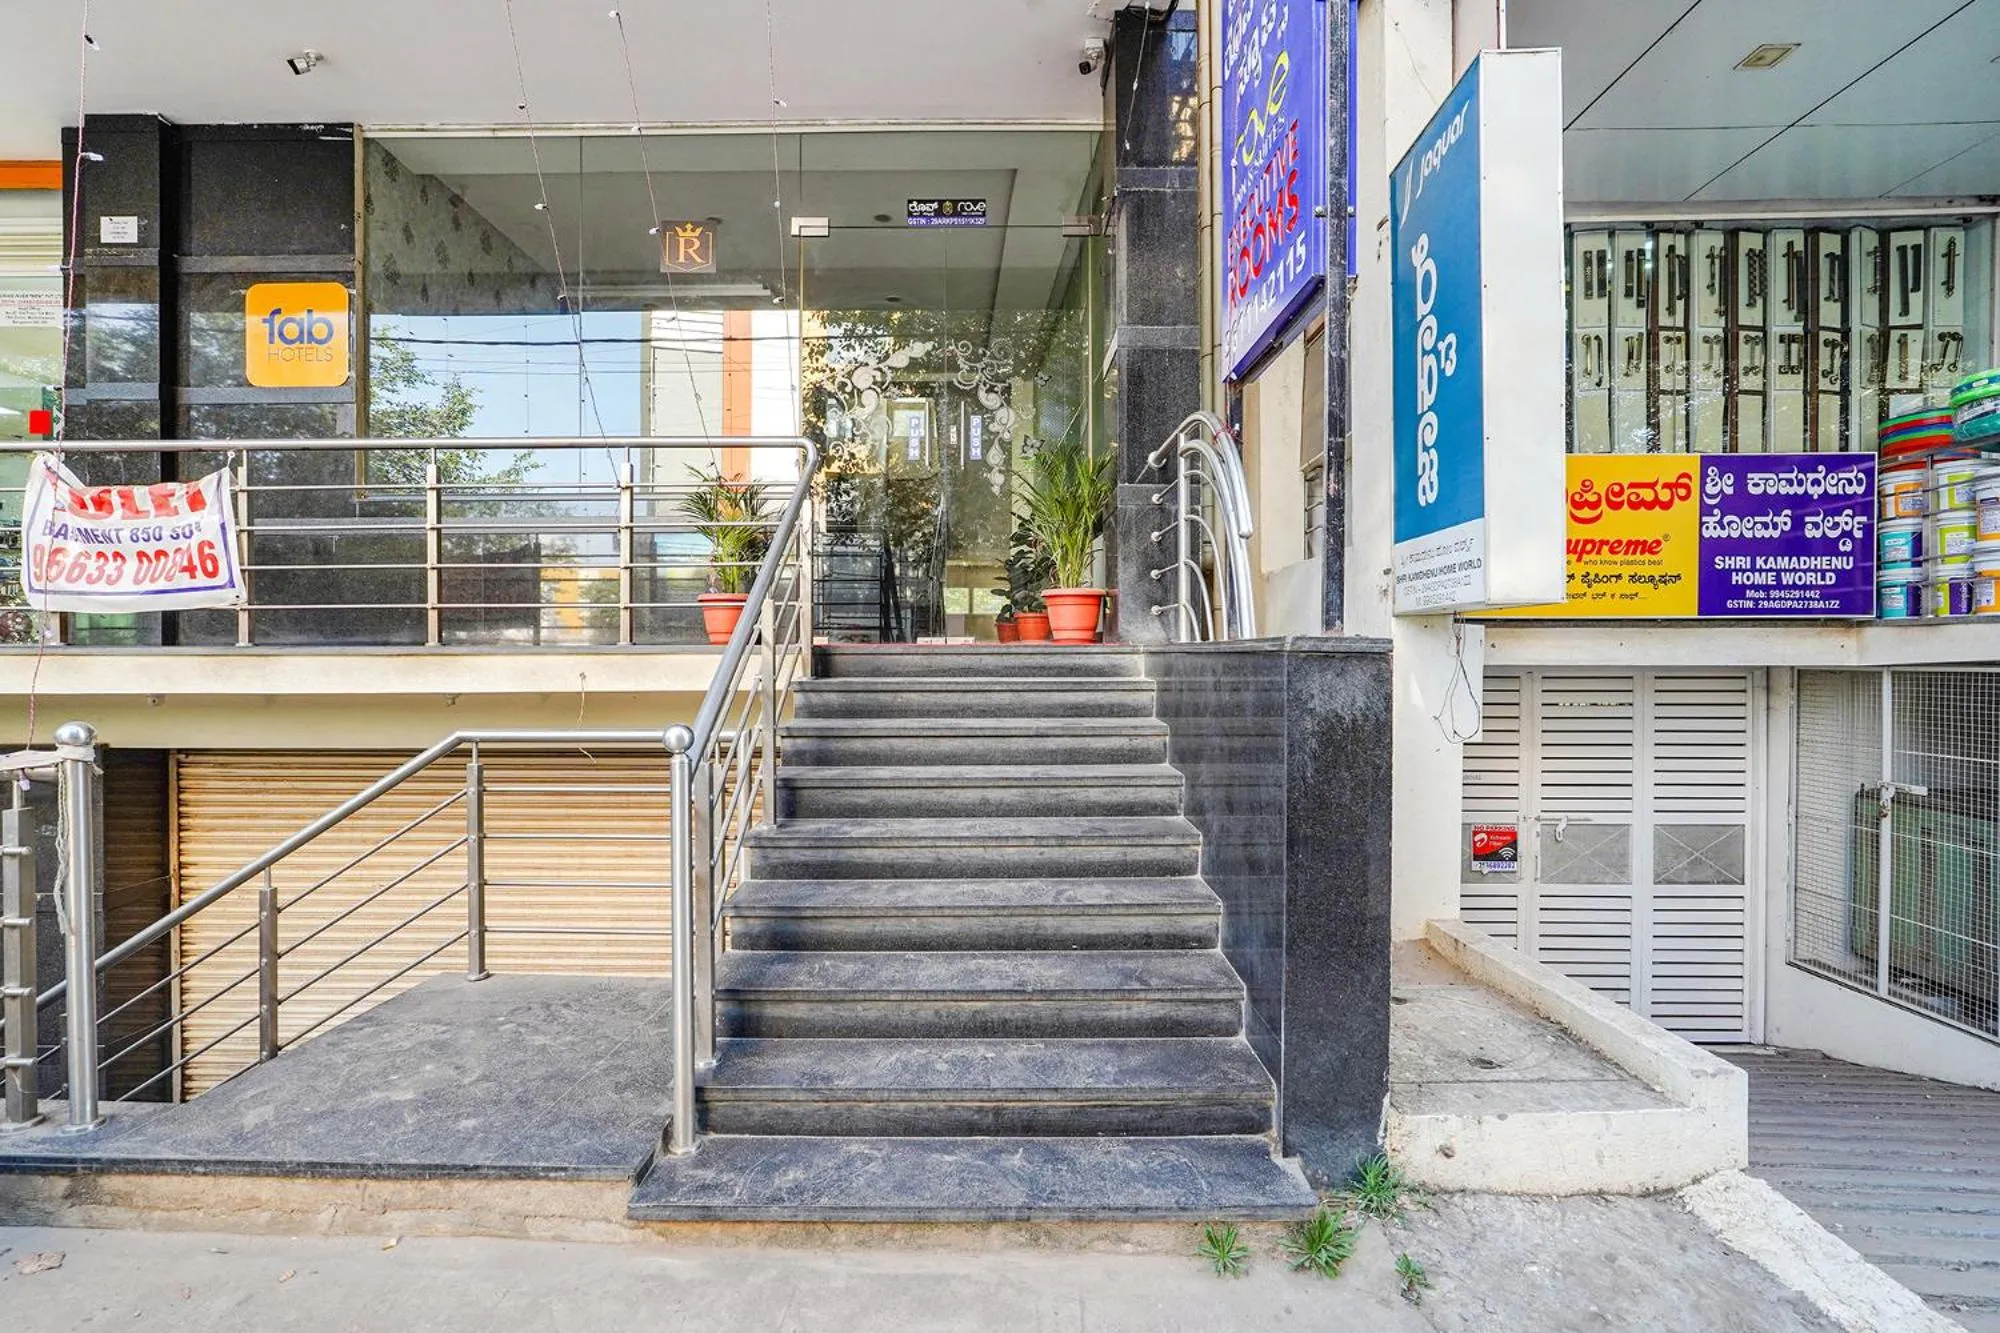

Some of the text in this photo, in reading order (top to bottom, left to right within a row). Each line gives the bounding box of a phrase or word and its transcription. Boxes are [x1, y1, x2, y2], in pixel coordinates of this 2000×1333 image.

[1228, 119, 1299, 270] EXECUTIVE
[676, 237, 706, 263] R
[1228, 169, 1299, 322] ROOMS
[262, 308, 334, 345] fab
[268, 347, 333, 361] HOTELS
[910, 418, 919, 457] PUSH
[971, 417, 981, 457] PUSH
[1702, 465, 1867, 505] ಶ್ರೀ ಕಾಮಧೇನು
[1566, 472, 1693, 525] ಪ್ರೀಮ್
[129, 525, 163, 543] 850
[1701, 508, 1792, 539] ಹೋಮ್
[1566, 538, 1663, 562] upreme
[1620, 559, 1646, 567] plastics
[1714, 556, 1854, 569] SHRI KAMADHENU
[32, 543, 127, 586] 96633
[1458, 557, 1482, 571] WORLD
[1731, 572, 1837, 585] HOME WORLD
[1727, 600, 1755, 609] GSTIN:
[1746, 590, 1767, 598] Mob:
